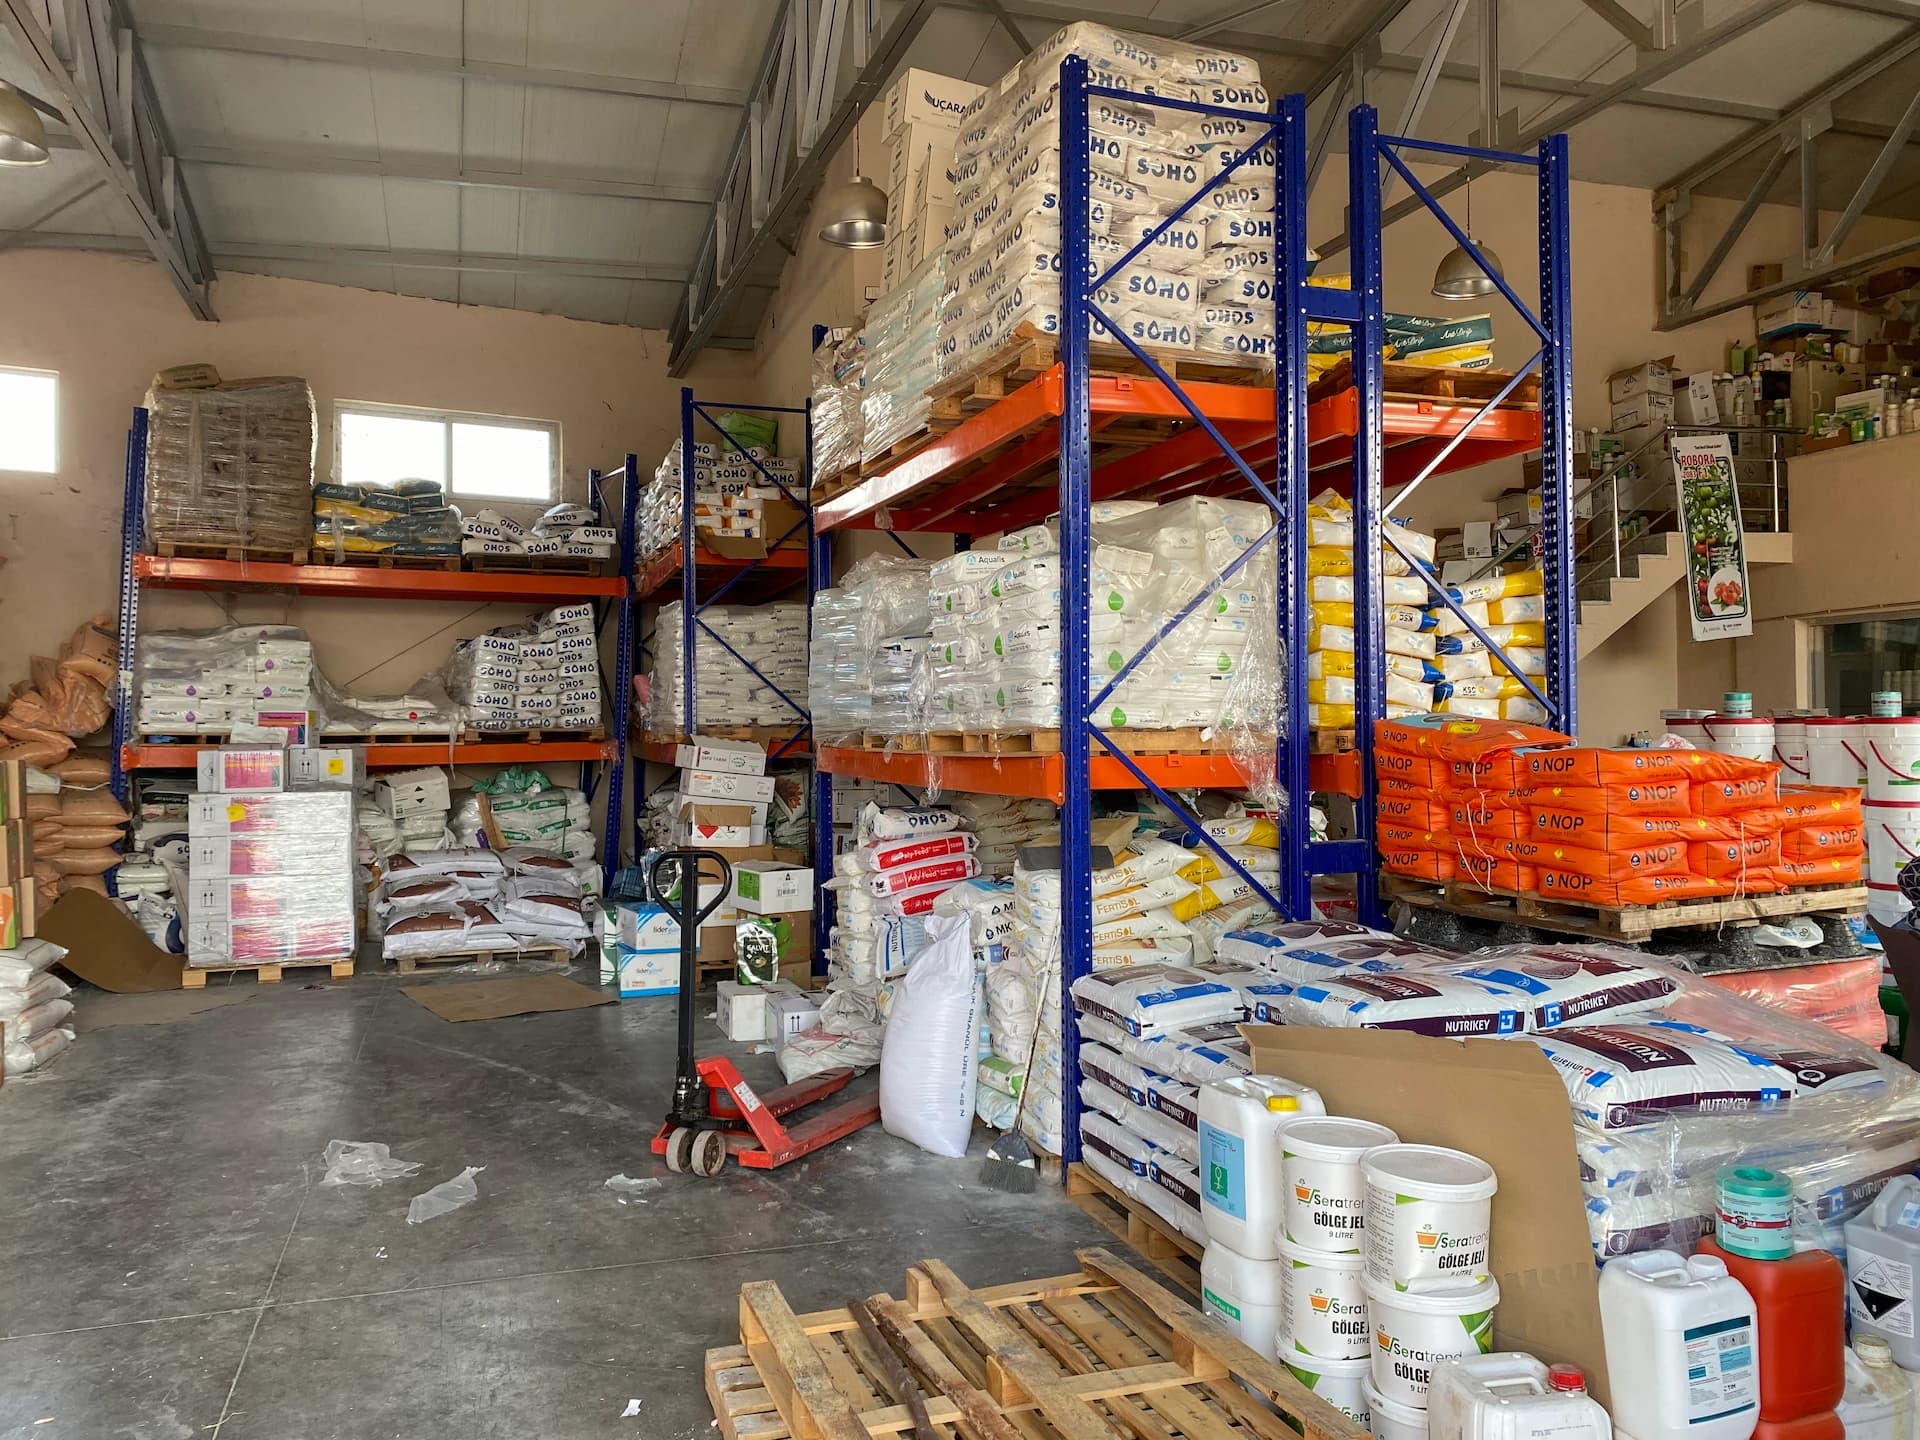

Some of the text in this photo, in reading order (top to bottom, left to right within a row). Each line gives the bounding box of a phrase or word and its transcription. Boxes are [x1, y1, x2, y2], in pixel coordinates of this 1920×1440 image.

[1195, 58, 1239, 75] SOHO
[1212, 87, 1267, 104] SOHO
[1100, 106, 1147, 137] SOHO
[1201, 120, 1246, 140] SOHO
[1220, 149, 1275, 167] SOHO
[1137, 158, 1197, 184] SOHO
[1213, 187, 1260, 209] SOHO
[1229, 218, 1274, 238] SOH
[1224, 251, 1268, 270] SOHO
[968, 260, 993, 289] SOHO
[1128, 275, 1190, 301] SOHO
[1132, 320, 1191, 345] SOHO
[728, 449, 758, 464] SOO
[1681, 453, 1716, 467] ROBORA
[716, 468, 747, 479] SOHO
[552, 513, 577, 522] SOHO
[467, 523, 501, 538] SOHO
[500, 518, 525, 537] SOHO
[583, 528, 613, 539] SOHO
[483, 543, 511, 553] SOHO
[527, 542, 558, 554] SOHO
[567, 546, 593, 555] SOHO
[559, 607, 589, 620] SOHO
[555, 625, 580, 637] SOHO
[483, 640, 515, 651] SOHO
[562, 637, 592, 649] SOHO
[522, 647, 553, 658] SOHO
[558, 653, 583, 664] SOHO
[564, 664, 595, 674] SOHO
[523, 673, 554, 684] SOHO
[566, 690, 597, 701] SOHO
[1462, 686, 1477, 694] KSC
[476, 695, 509, 706] SOHO
[520, 699, 552, 709] SOHO
[559, 706, 586, 716] SOHO
[564, 717, 595, 728] SOHO
[1390, 731, 1407, 743] NOP
[1387, 757, 1413, 771] NOP
[1464, 762, 1493, 775] NOP
[1543, 757, 1575, 772] NOP
[1646, 755, 1673, 768] NOP
[1396, 780, 1415, 791] NOP
[1643, 785, 1678, 800] NOP
[1736, 779, 1767, 795] NOP
[1387, 801, 1411, 815] NOP
[908, 813, 947, 828] SOHO
[1465, 811, 1494, 825] NOP
[1550, 814, 1585, 831] NOP
[1211, 827, 1226, 835] KSC
[1655, 820, 1681, 831] NOP
[1393, 830, 1413, 840] NOP
[1831, 828, 1858, 844] NOP
[1515, 844, 1538, 856] NOP
[1741, 838, 1772, 855] NOP
[1391, 853, 1419, 866] NOP
[1645, 846, 1677, 865] NOP
[1469, 859, 1498, 873] NOP
[1557, 873, 1593, 890] NOP
[1664, 876, 1689, 889] NOP
[1233, 886, 1249, 896] KSC
[1568, 994, 1609, 1015] NUTRIKEY
[1445, 1019, 1490, 1033] NUTRIKEY
[1161, 1099, 1185, 1121] NUTRIKEY
[1699, 1097, 1750, 1112] NUTRIKEY
[1313, 1211, 1364, 1229] GÖLGE JEL
[1438, 1253, 1469, 1270] GÖLGE
[1332, 1320, 1365, 1335] GÖLGE
[1347, 1337, 1352, 1345] 9
[1394, 1343, 1462, 1363] Seratrend
[1394, 1361, 1430, 1383] GÖLGE
[1410, 1384, 1415, 1392] 9
